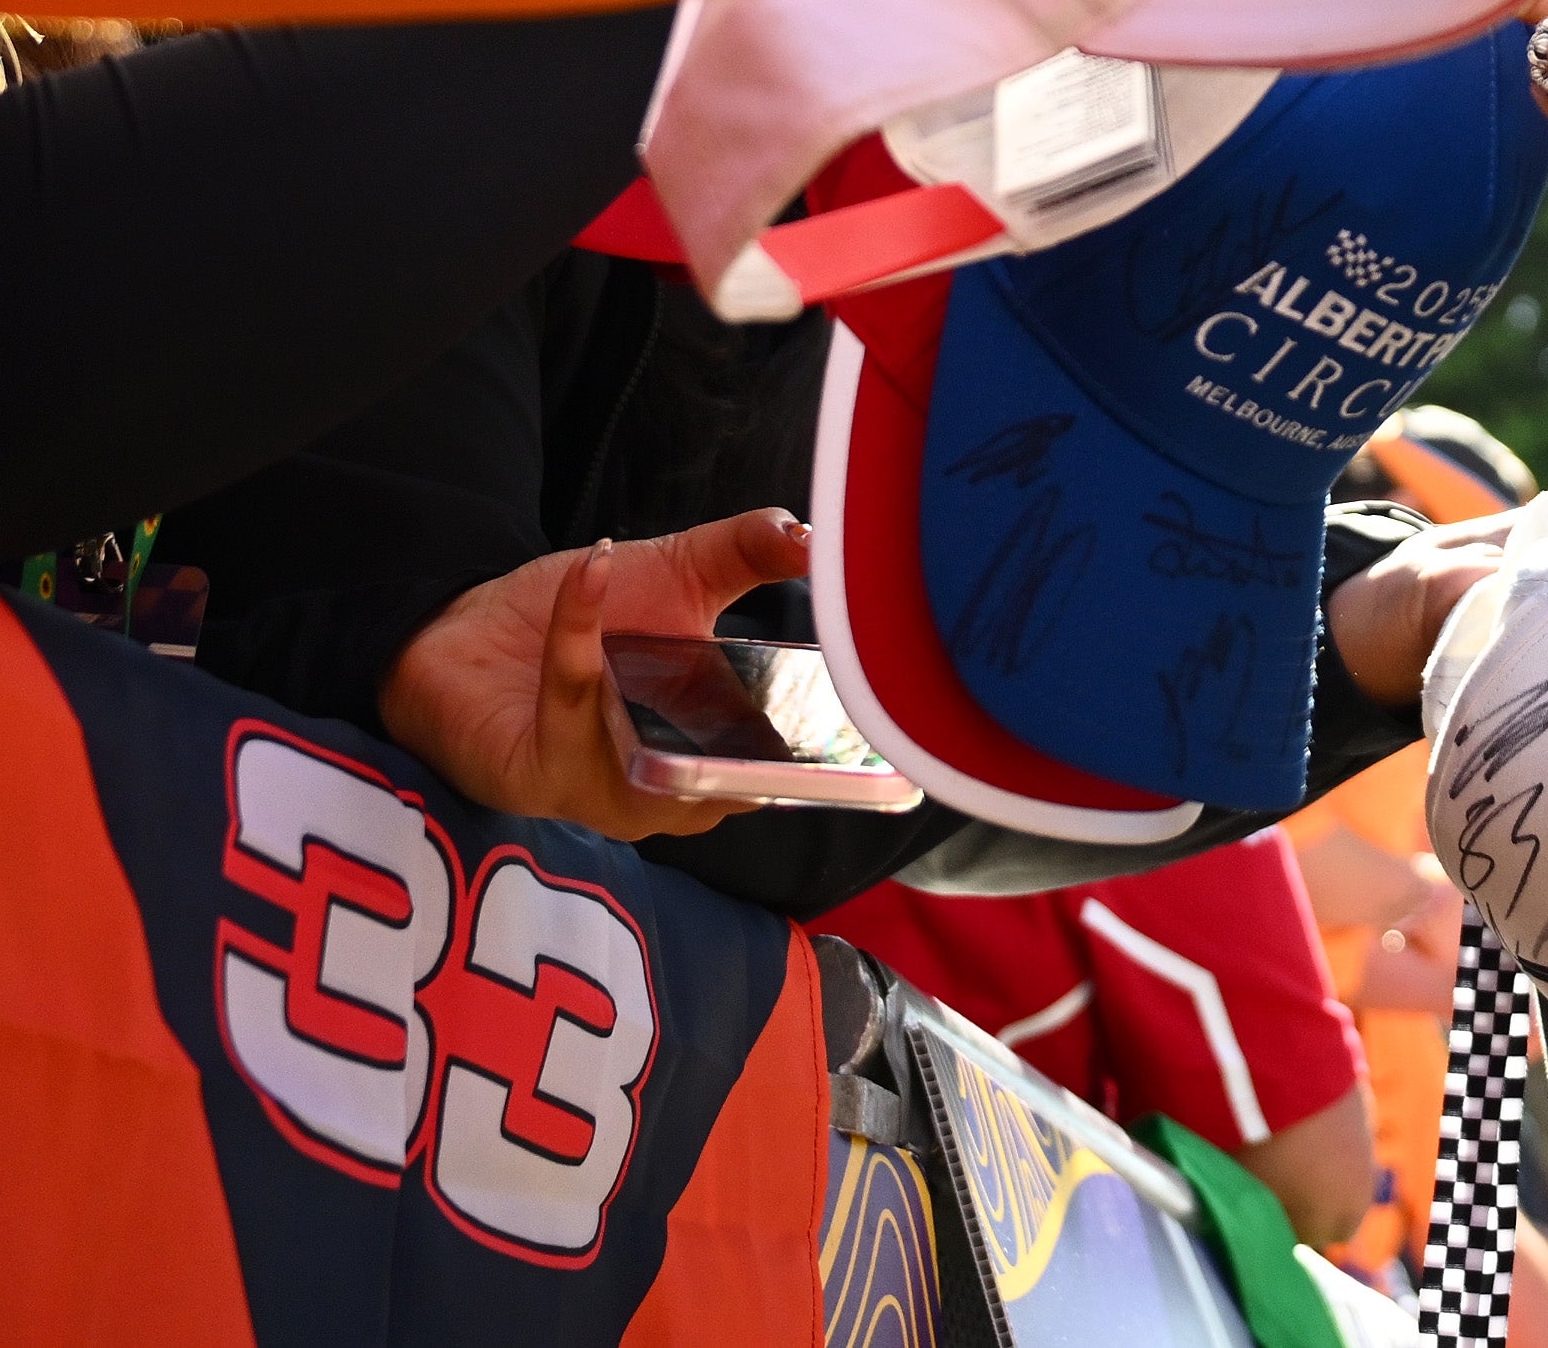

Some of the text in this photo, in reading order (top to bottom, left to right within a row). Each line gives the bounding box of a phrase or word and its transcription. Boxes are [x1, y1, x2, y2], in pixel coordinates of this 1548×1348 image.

[1195, 311, 1418, 419] CIRCU
[1234, 260, 1436, 368] ALBERT
[215, 718, 659, 1269] 33
